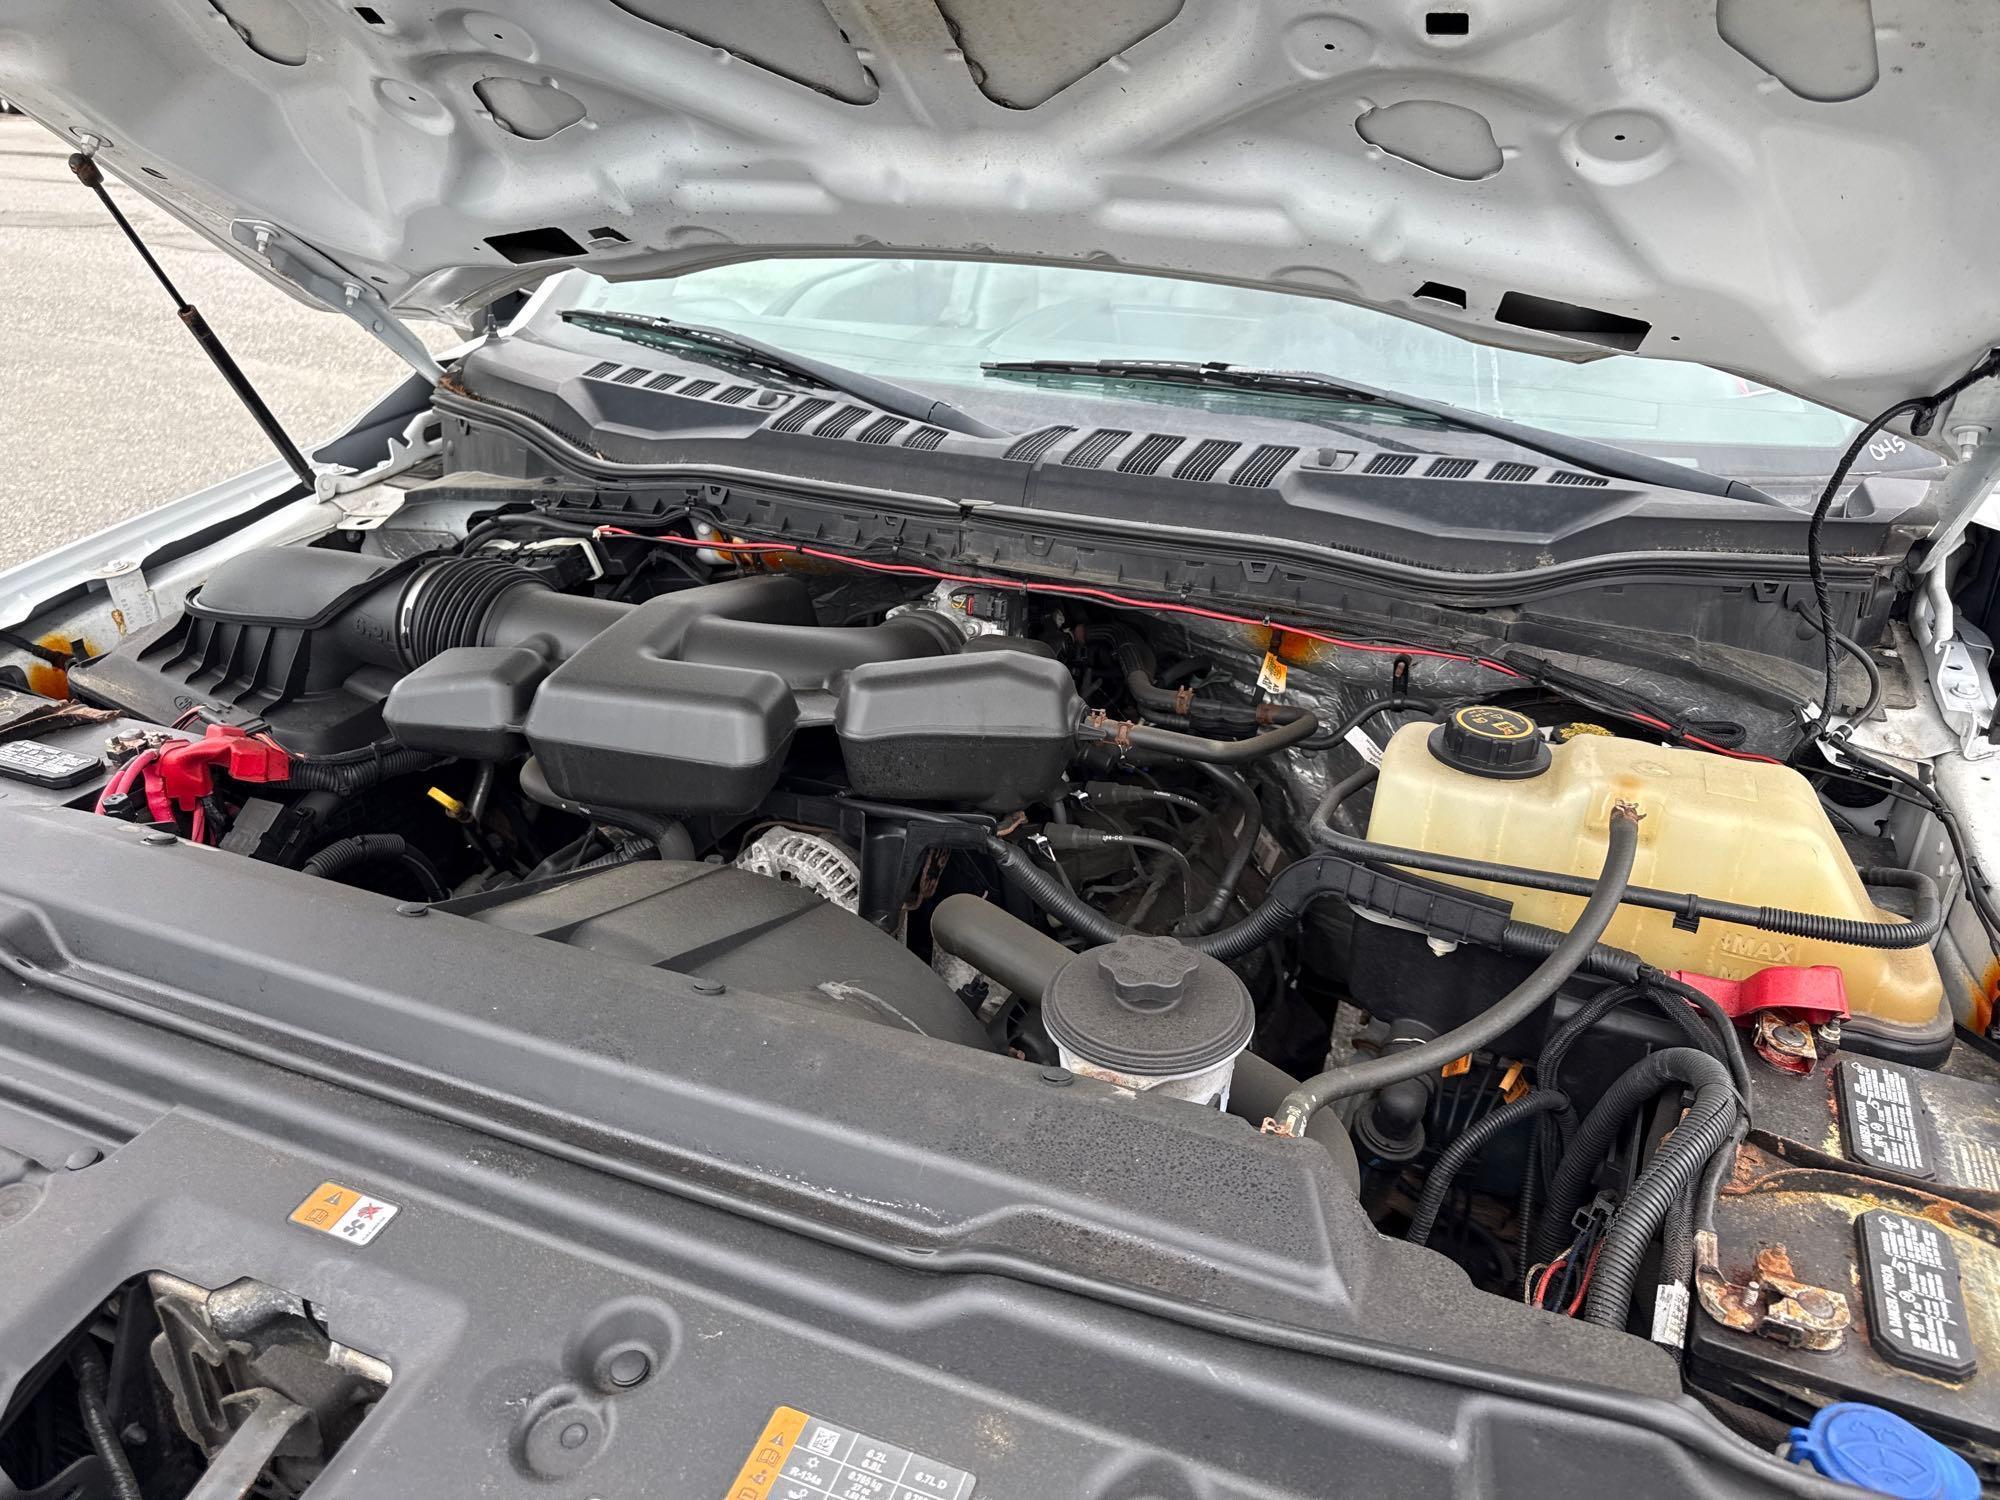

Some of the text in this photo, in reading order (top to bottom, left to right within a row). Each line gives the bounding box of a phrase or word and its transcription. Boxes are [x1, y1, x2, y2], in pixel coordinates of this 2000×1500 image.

[1869, 435, 1906, 461] 045
[1731, 933, 1795, 964] MAX
[865, 1449, 888, 1465] 6.2L
[914, 1471, 948, 1490] 6.7L D
